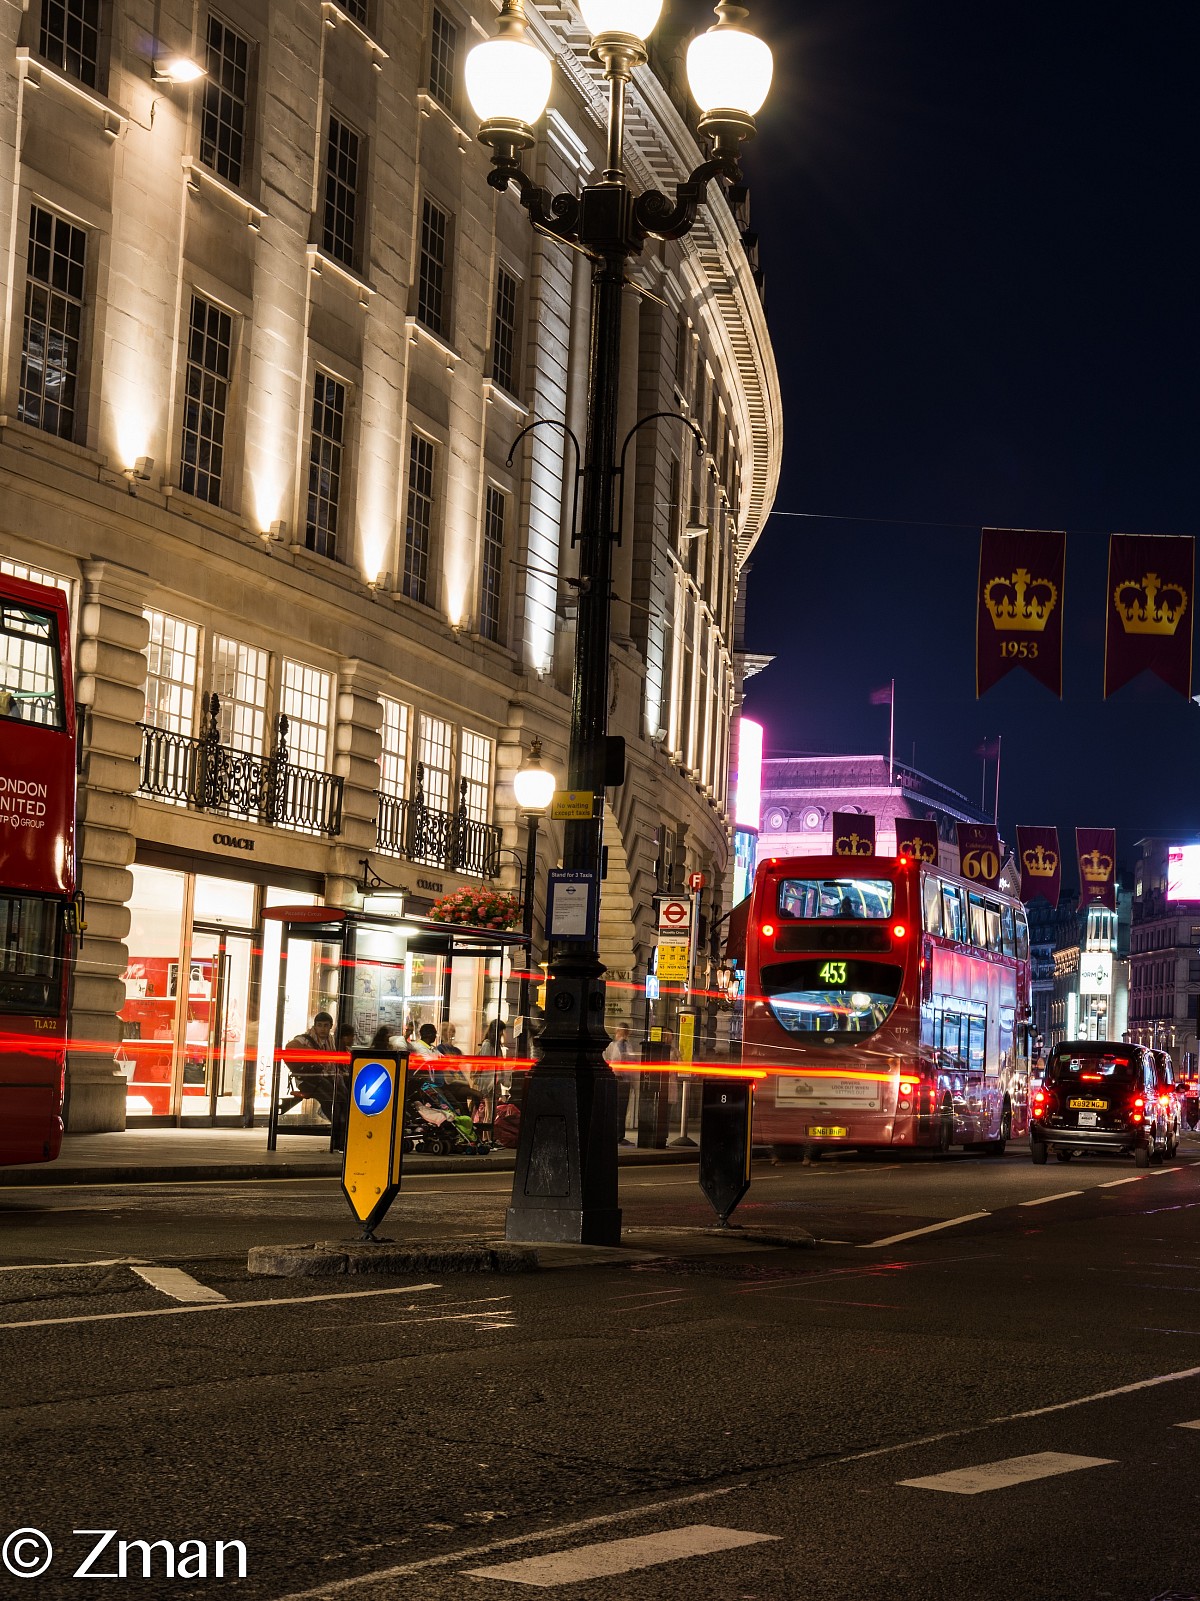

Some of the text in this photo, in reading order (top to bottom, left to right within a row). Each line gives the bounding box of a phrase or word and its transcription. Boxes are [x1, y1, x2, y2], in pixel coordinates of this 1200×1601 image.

[999, 641, 1039, 659] 1953
[0, 777, 47, 798] ONDON
[0, 796, 46, 816] NITED
[20, 818, 45, 829] GROUP
[212, 833, 255, 850] COACH
[962, 850, 999, 880] 60
[416, 878, 444, 894] COACH
[692, 875, 702, 887] F
[820, 962, 847, 983] 453
[1081, 970, 1109, 981] ORMON
[33, 1020, 57, 1029] TLA22
[721, 1094, 727, 1104] 8
[1072, 1100, 1090, 1108] X892
